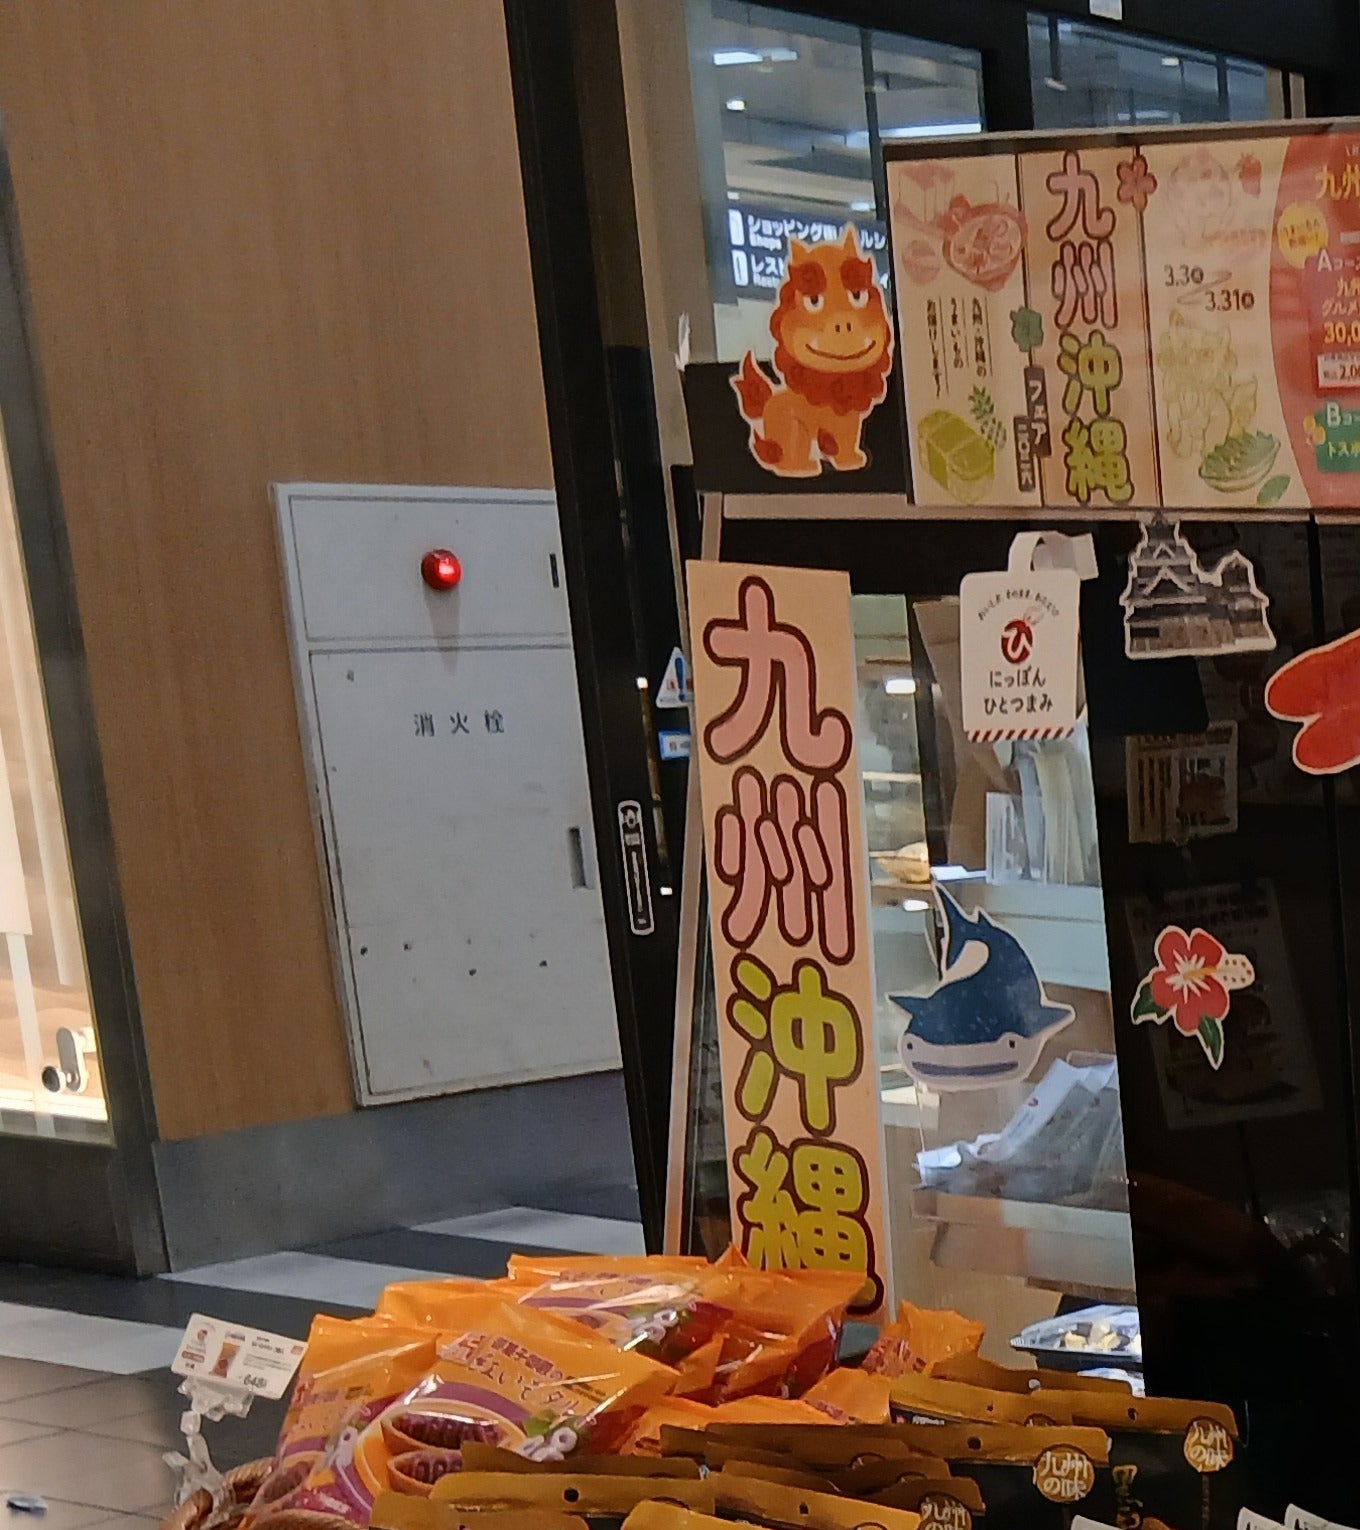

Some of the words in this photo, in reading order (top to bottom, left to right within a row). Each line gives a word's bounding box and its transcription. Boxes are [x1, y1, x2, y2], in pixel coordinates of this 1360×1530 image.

[1046, 149, 1135, 502] 九州沖縄
[989, 664, 1047, 689] にっぽん
[984, 693, 1053, 716] ひとつまみ
[413, 709, 506, 739] 消火栓
[703, 575, 885, 1315] 九州沖縄
[1039, 1453, 1095, 1480] 九州
[1042, 1475, 1094, 1501] の味
